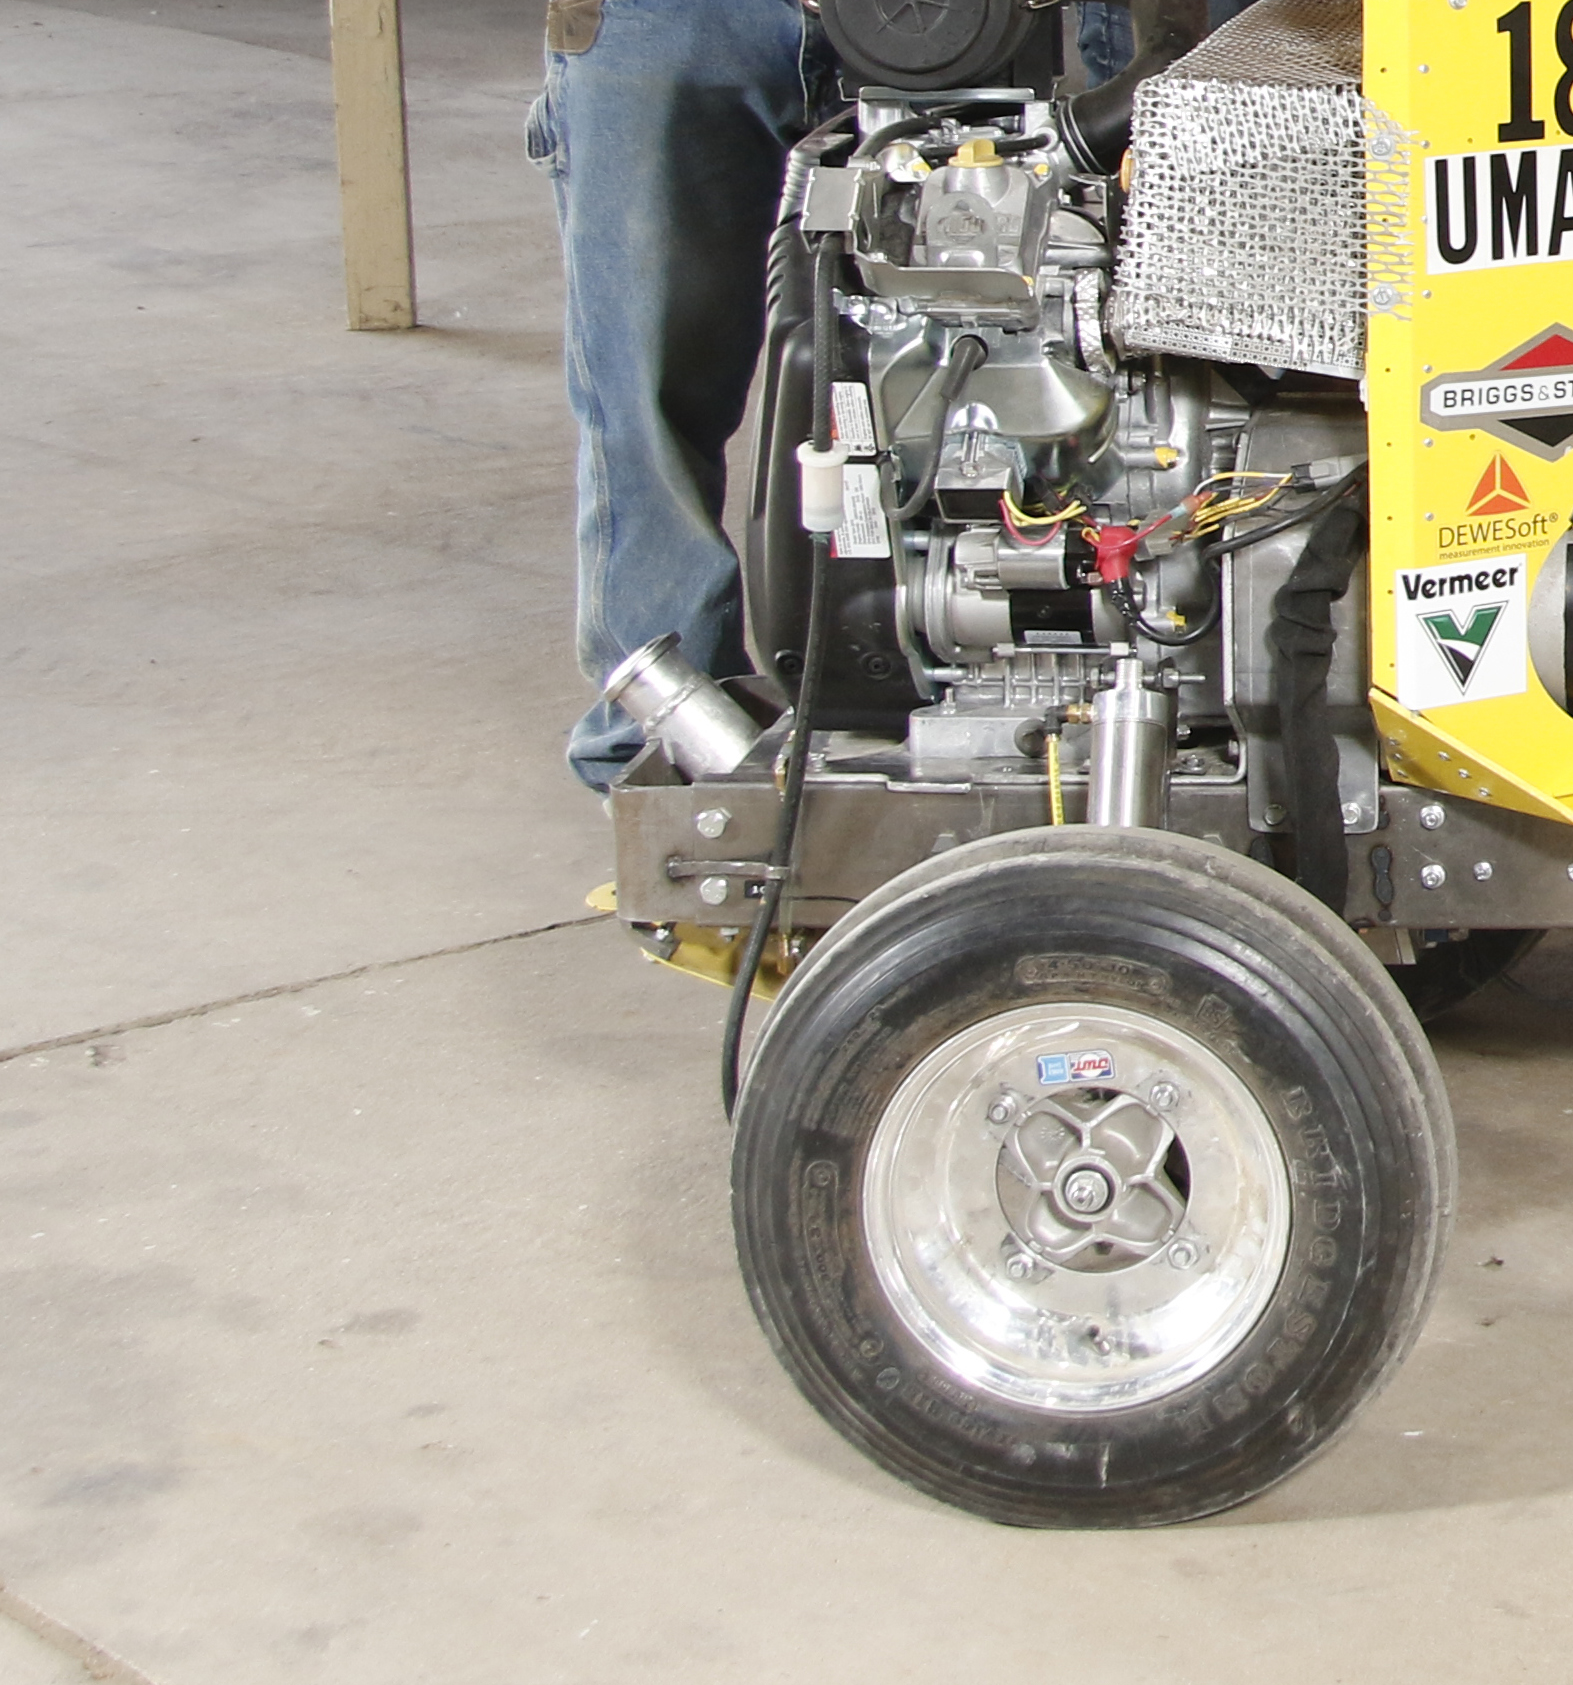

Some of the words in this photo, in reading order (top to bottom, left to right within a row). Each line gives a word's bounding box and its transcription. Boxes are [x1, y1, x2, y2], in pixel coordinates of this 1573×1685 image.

[1443, 383, 1535, 409] BRIGGS
[1538, 384, 1551, 401] &
[1439, 544, 1500, 560] measurement
[1502, 538, 1550, 552] innovation
[1402, 565, 1519, 601] Vermeer
